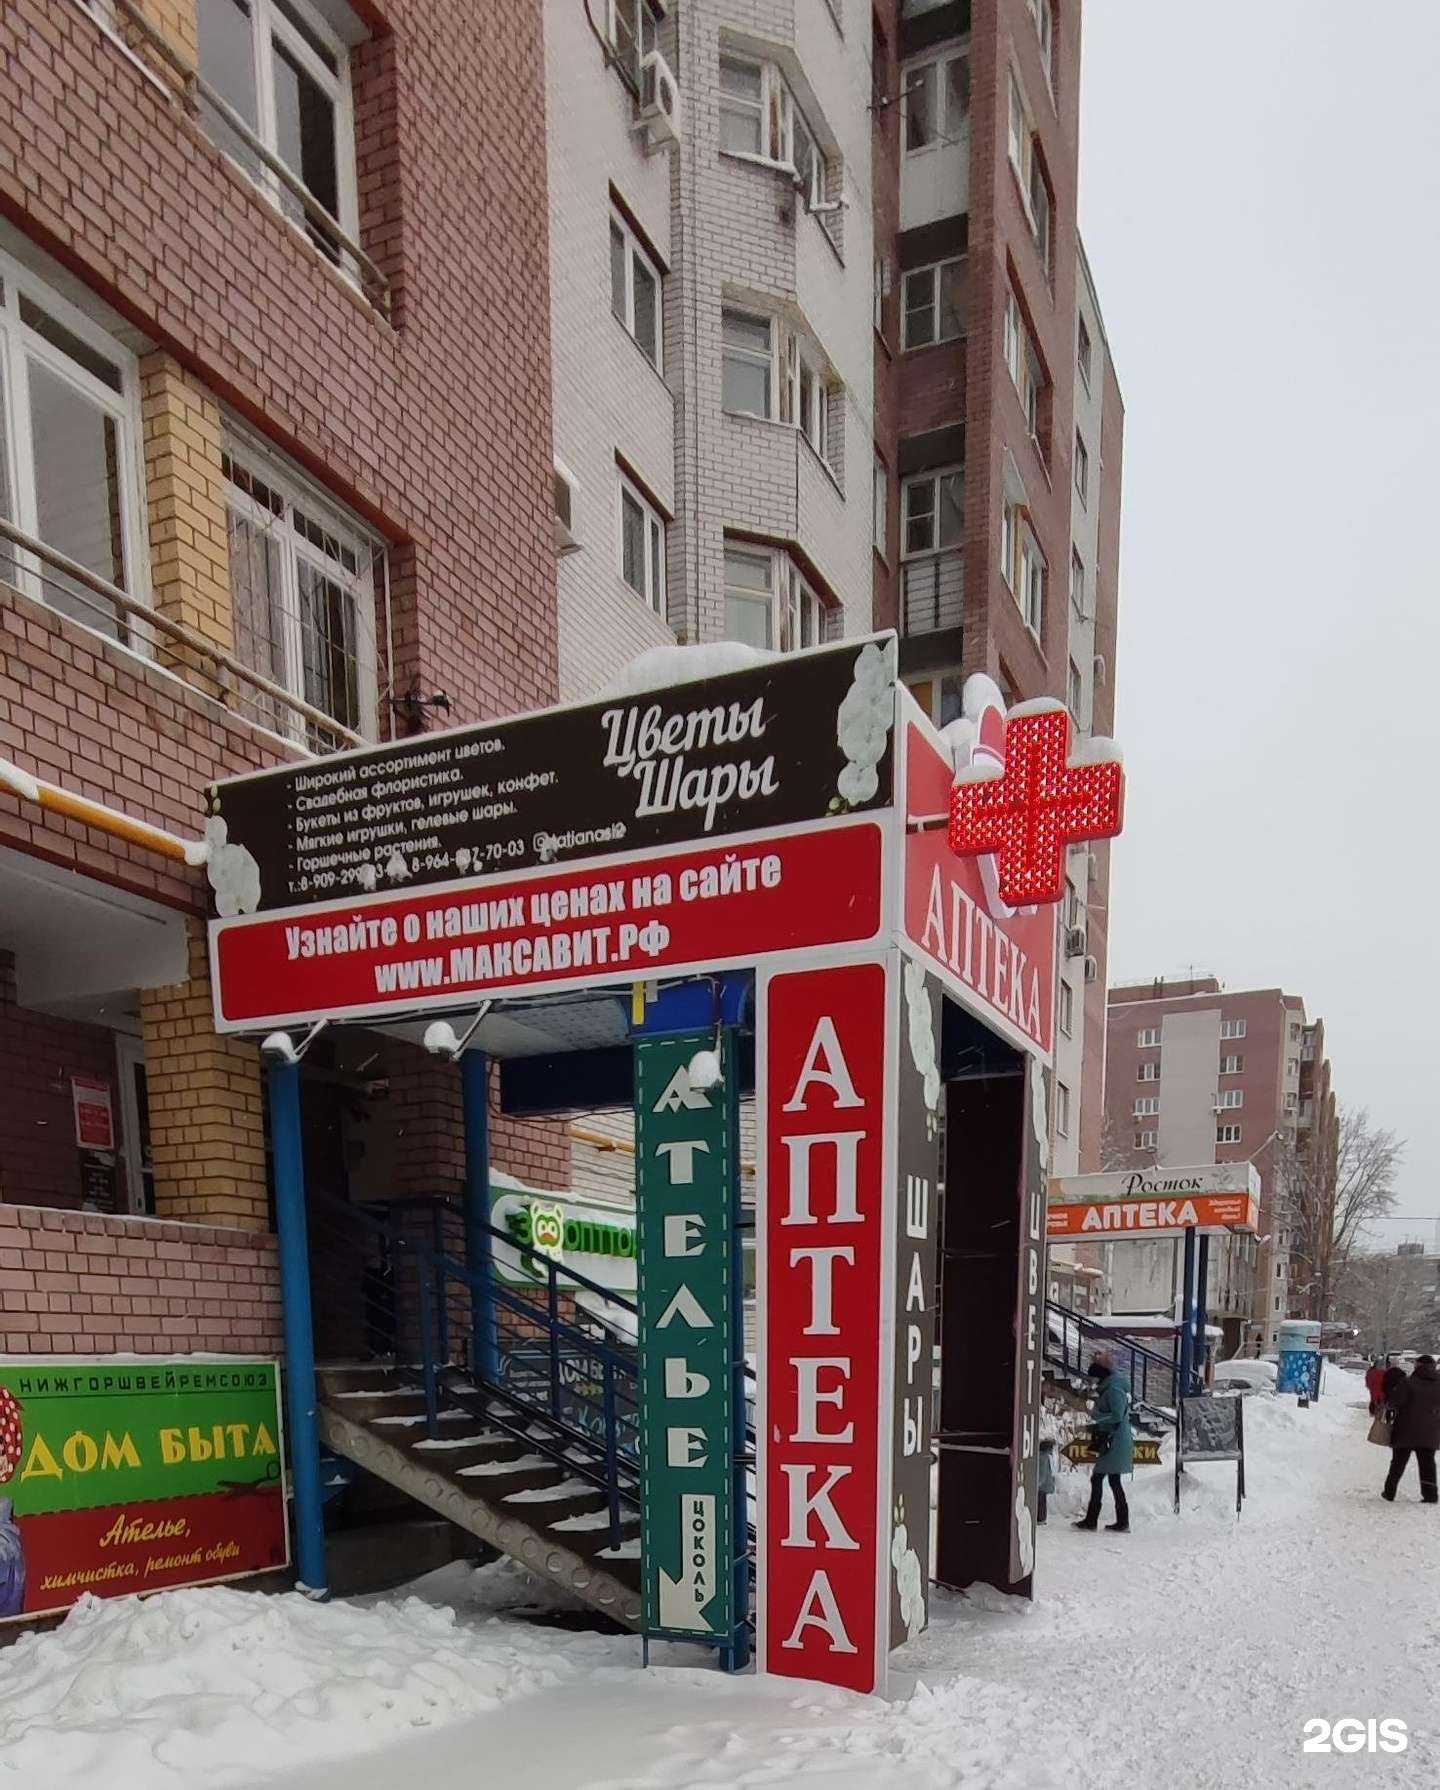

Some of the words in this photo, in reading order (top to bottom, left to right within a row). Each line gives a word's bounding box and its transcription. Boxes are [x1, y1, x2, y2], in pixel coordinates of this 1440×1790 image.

[295, 766, 356, 791] Широкий
[359, 750, 451, 779] ассортимент
[455, 738, 505, 759] цветов.
[601, 697, 767, 777] Цветы
[296, 786, 368, 811] Свадебная
[371, 768, 464, 799] флористика.
[296, 812, 341, 833] Букеты
[343, 808, 359, 823] из
[361, 797, 425, 822] фруктов,
[428, 784, 493, 806] игрушек,
[498, 771, 559, 794] конфет.
[633, 755, 780, 831] Шары
[296, 832, 344, 851] Мягкие
[347, 821, 408, 842] игрушки,
[411, 809, 468, 831] гелевые
[472, 801, 519, 821] шары.
[297, 848, 371, 872] Горшечные
[374, 835, 442, 861] растения.
[285, 914, 398, 960] Узнайте
[403, 913, 421, 943] о
[426, 896, 526, 940] наших
[530, 880, 626, 927] ценах
[632, 873, 673, 909] на
[679, 853, 782, 902] сайте
[375, 919, 671, 993] www.МАКСАВИТ.РФ
[920, 863, 1043, 1043] АПТЕКА
[1081, 1199, 1199, 1231] АПТЕКА
[1121, 1172, 1204, 1196] Росток
[651, 1064, 715, 1468] АТЕЛЬЕ
[780, 1015, 867, 1655] АПТЕКА
[903, 1173, 929, 1457] ШАРЫ
[1022, 1192, 1041, 1459] ЦВЕТЫ
[19, 1371, 269, 1394] НИЖГОРШВЕЙРЕМСОЮЗ
[20, 1430, 142, 1484] ДОМ
[159, 1421, 277, 1465] БЫТА
[99, 1513, 193, 1548] Ателье,
[692, 1500, 705, 1603] ЦОКОЛЬ
[39, 1560, 140, 1591] химчистка,
[143, 1547, 203, 1579] ремонт
[205, 1540, 241, 1567] обуви
